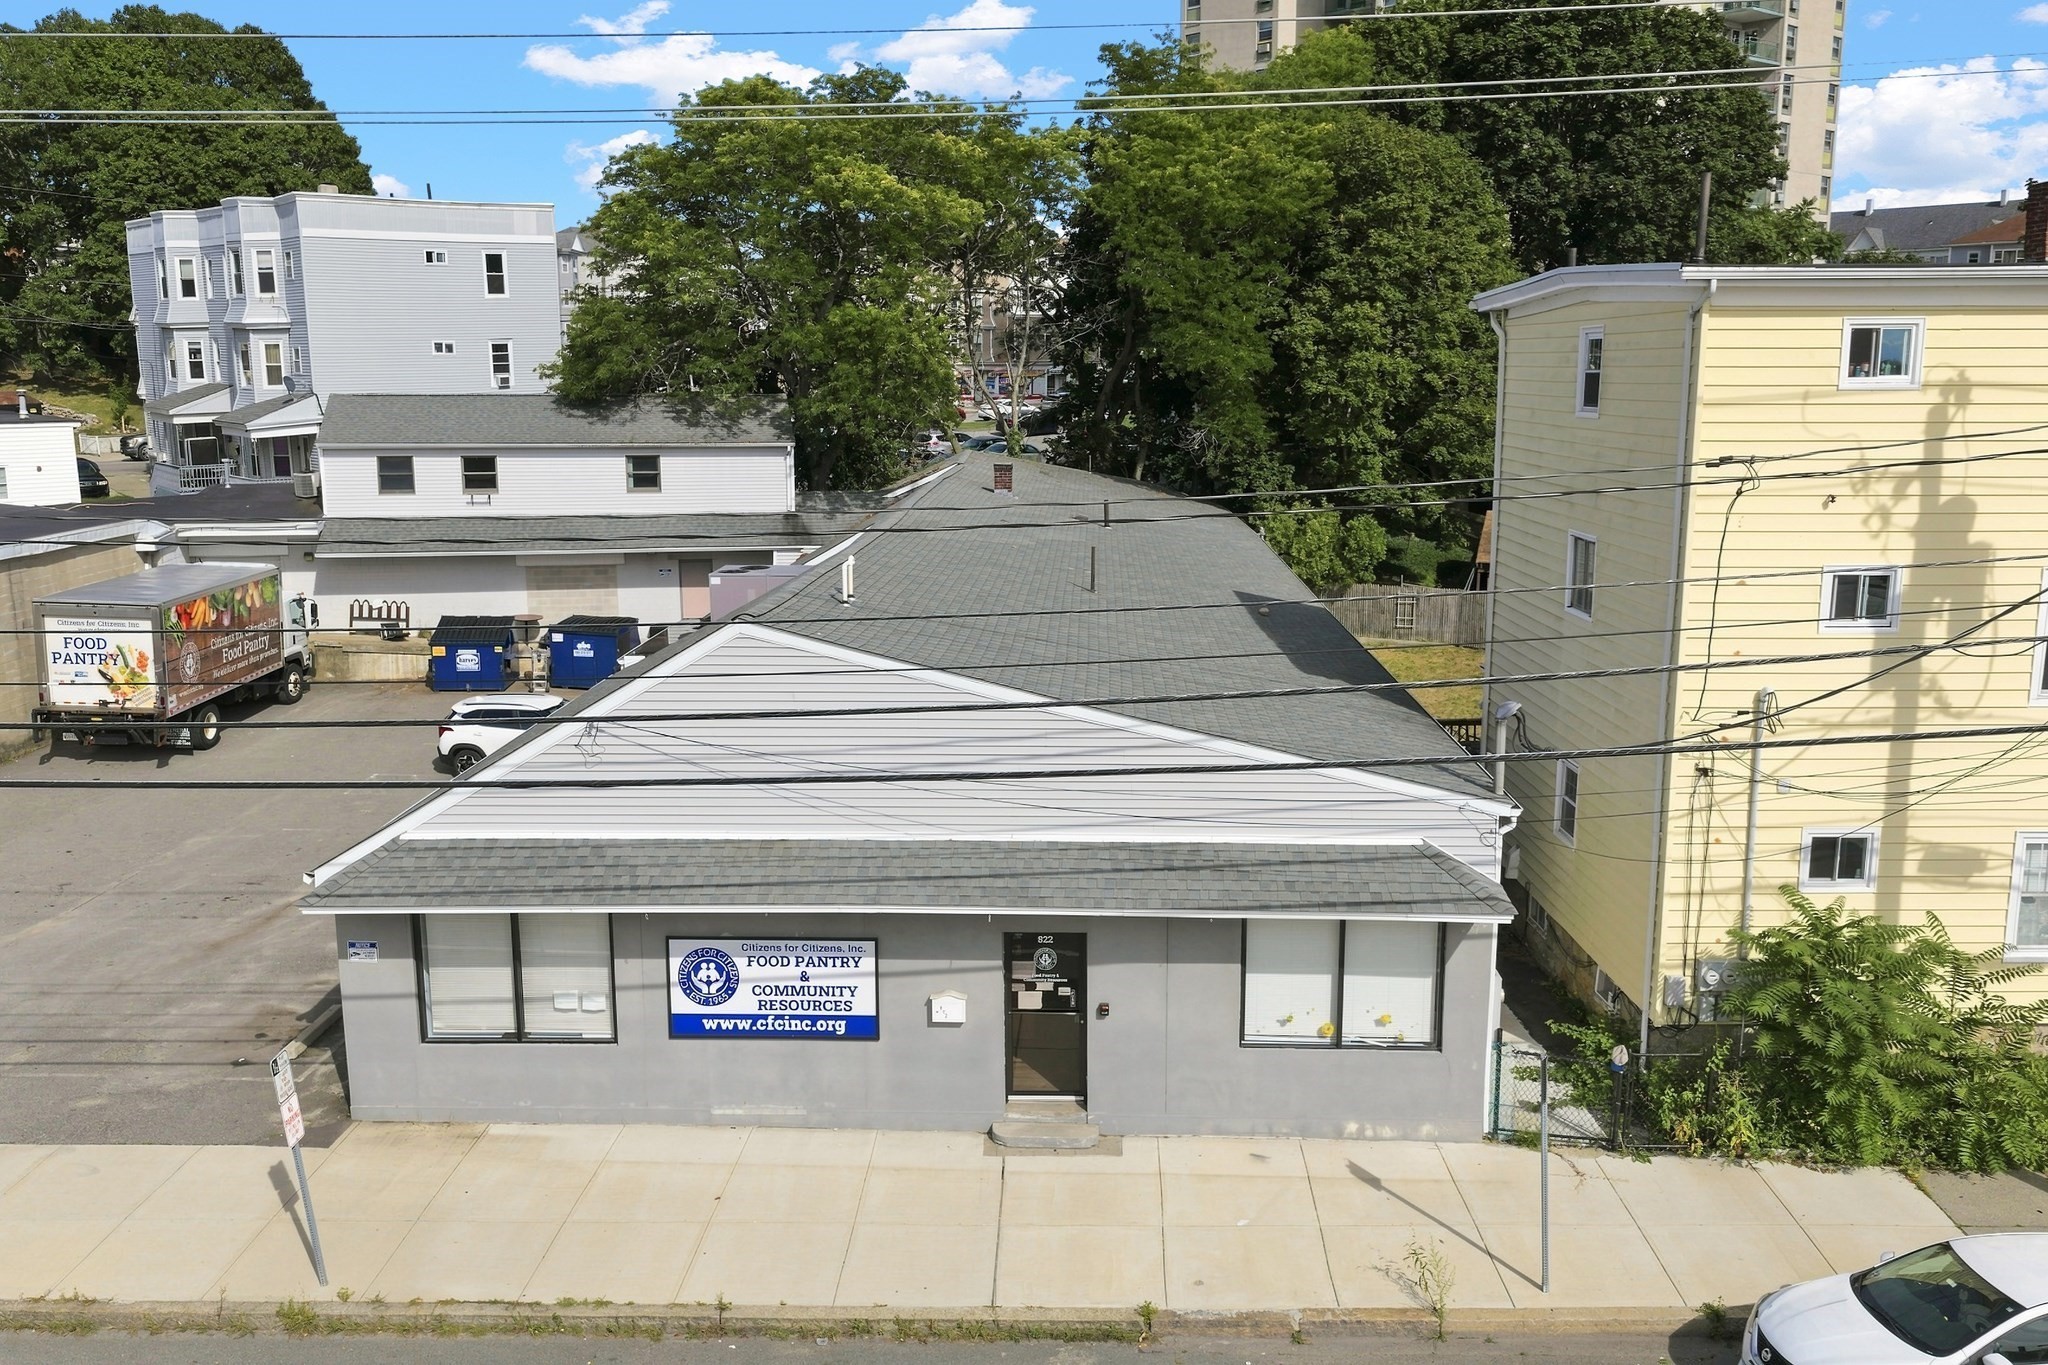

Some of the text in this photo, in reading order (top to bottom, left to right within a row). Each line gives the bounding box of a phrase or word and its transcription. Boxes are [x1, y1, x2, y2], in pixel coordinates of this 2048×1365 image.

[63, 636, 107, 650] FOOD
[222, 641, 243, 663] Food
[244, 634, 270, 655] Pantry
[51, 651, 120, 666] PANTRY
[1037, 935, 1054, 944] 822
[741, 943, 782, 952] Citizens
[785, 943, 799, 952] for
[848, 944, 867, 953] Inc.
[746, 955, 863, 968] FOOD PANTRY
[679, 948, 739, 989] CITIZENS FOR CITIZENS
[800, 970, 810, 982] &
[751, 985, 858, 998] COMMUNITY
[689, 991, 729, 1006] EST. 1965
[757, 1000, 853, 1012] RESOURCES
[702, 1015, 846, 1035] www.cfcinc.org
